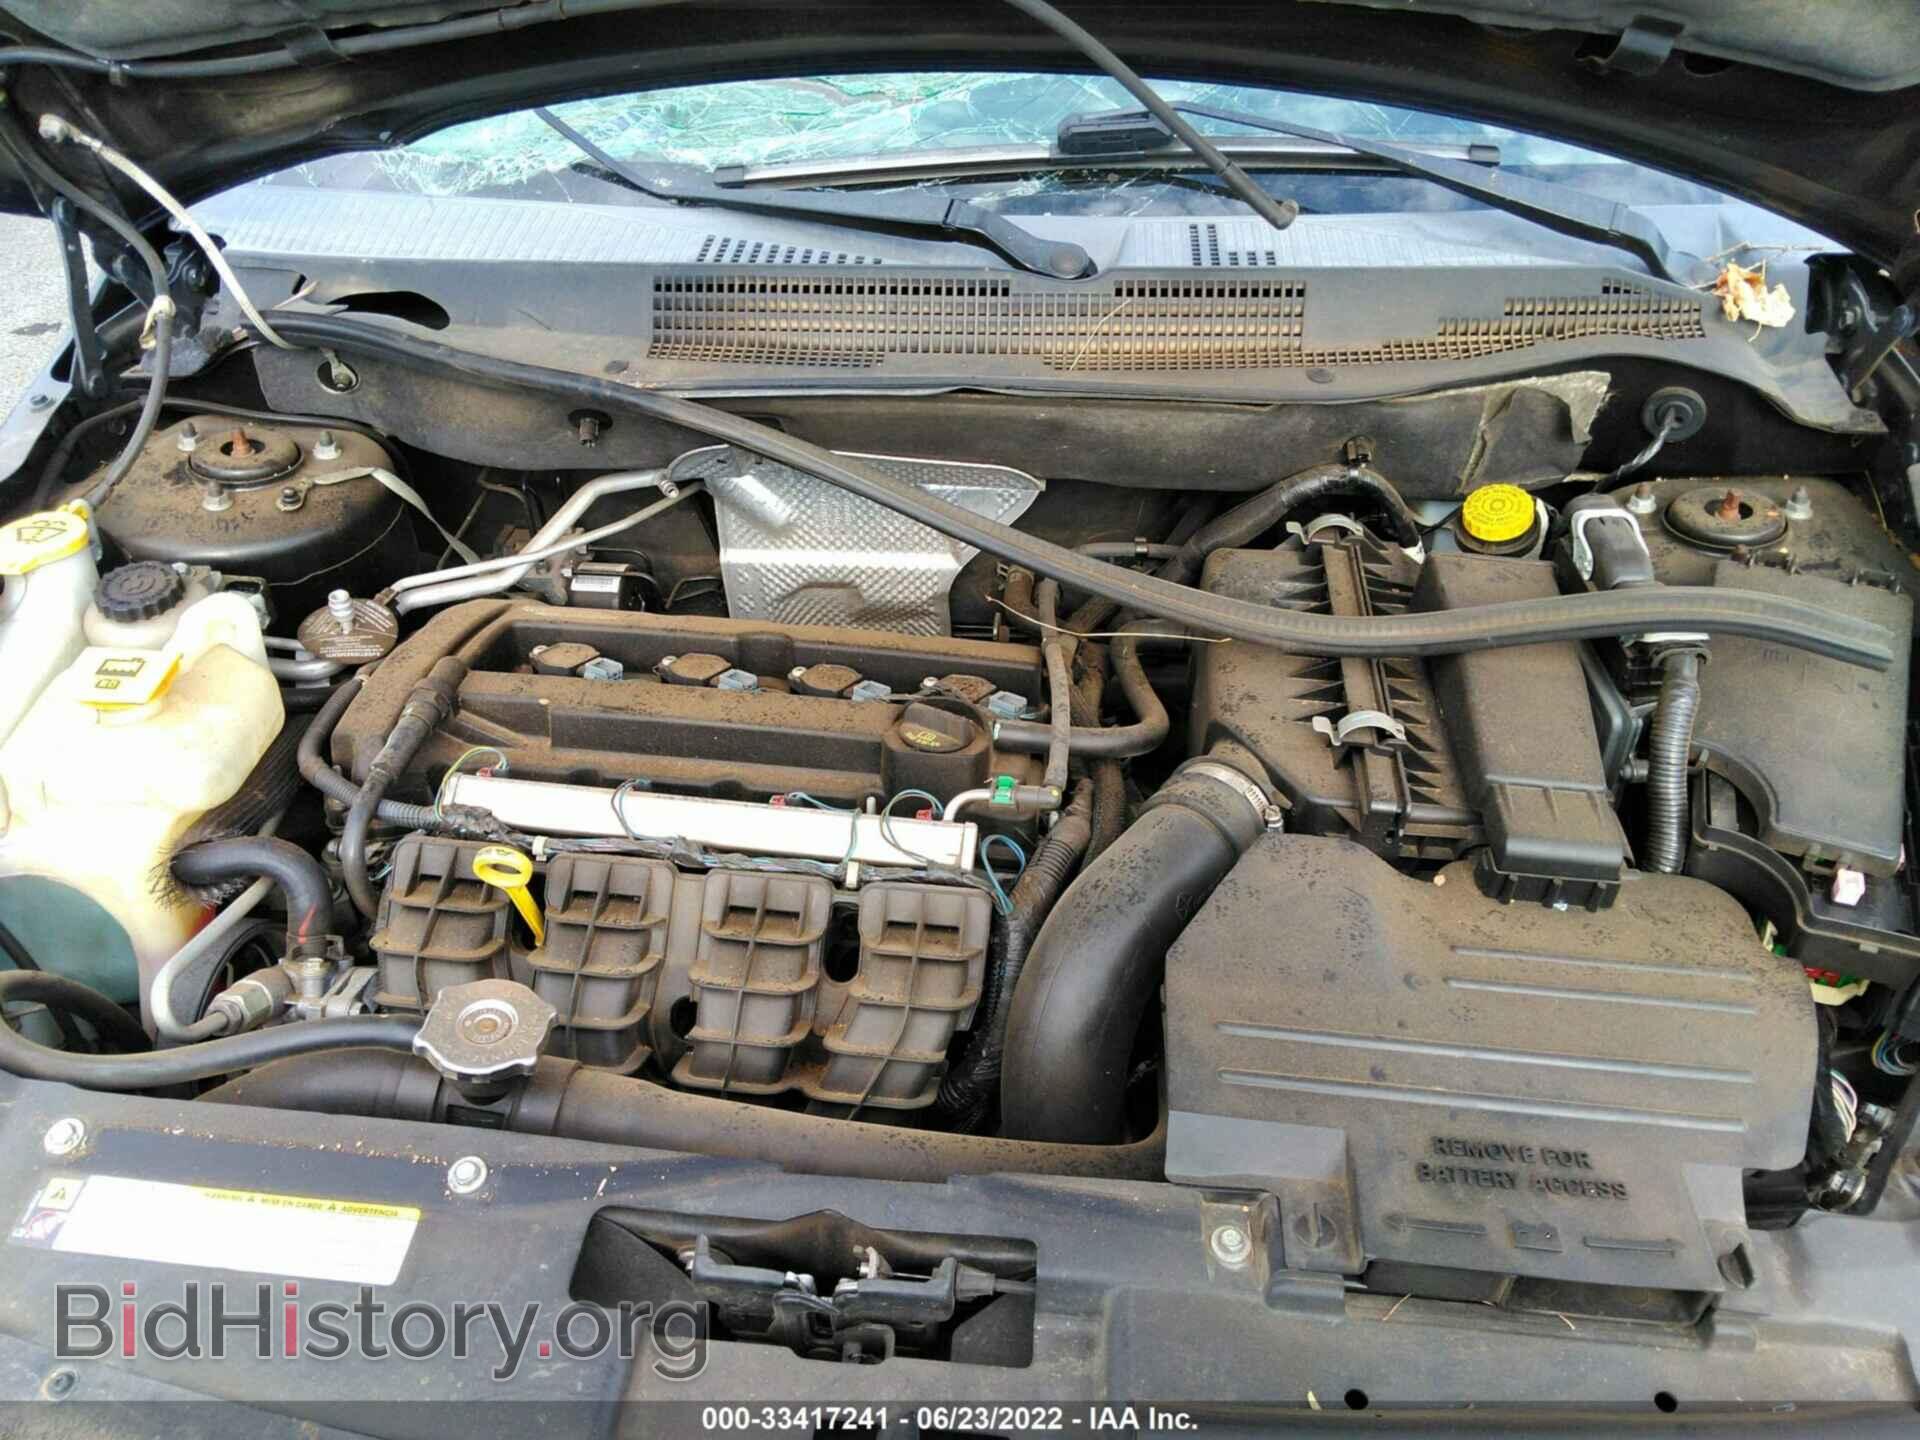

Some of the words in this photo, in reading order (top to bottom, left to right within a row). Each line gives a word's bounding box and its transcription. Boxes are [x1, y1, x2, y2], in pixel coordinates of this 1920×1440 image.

[1431, 1136, 1537, 1164] REMOVE
[1541, 1146, 1593, 1170] FOR
[1415, 1161, 1519, 1190] BATTERY
[1529, 1175, 1628, 1200] ACCESS
